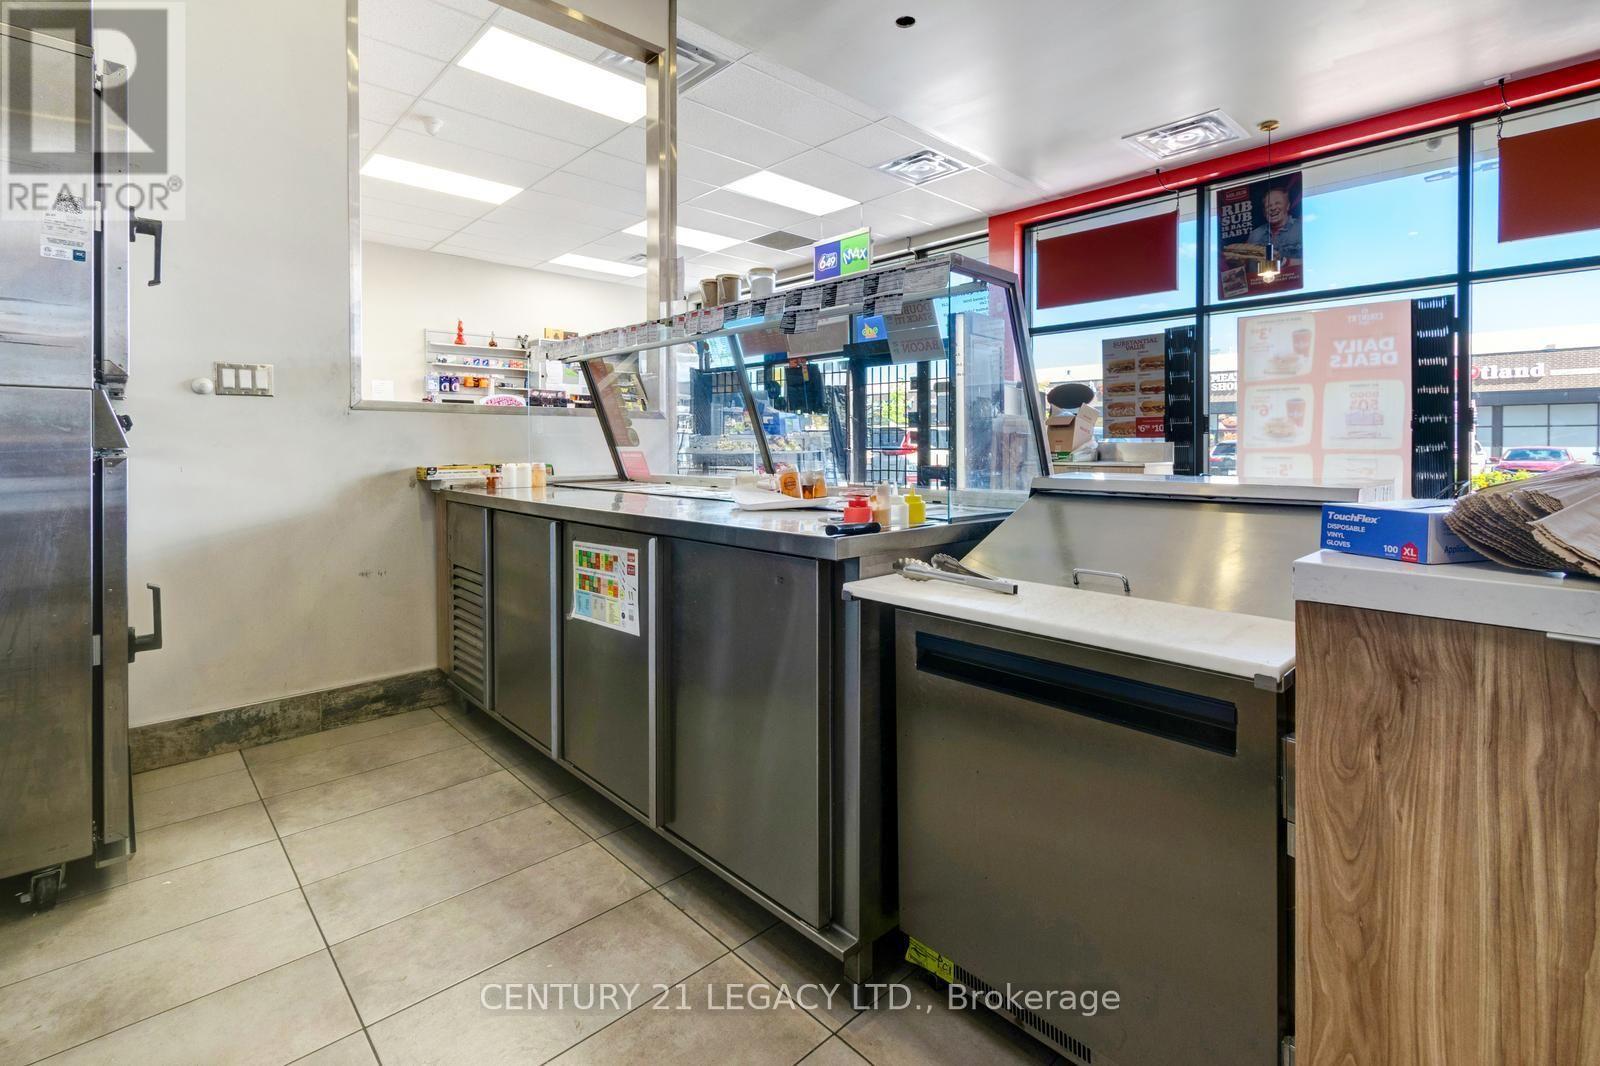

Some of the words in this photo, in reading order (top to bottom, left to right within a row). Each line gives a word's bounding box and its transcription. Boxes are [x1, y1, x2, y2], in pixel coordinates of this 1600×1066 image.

[1222, 200, 1253, 216] RIB
[1222, 212, 1253, 226] SUB
[1231, 222, 1253, 230] BACK
[1222, 228, 1253, 239] BABY!
[843, 247, 868, 265] MAX
[1210, 374, 1237, 383] MEA
[1327, 511, 1379, 524] TouchFlex
[1327, 522, 1366, 533] DISPOSABLE
[1327, 531, 1345, 539] VINYL
[1326, 539, 1351, 548] GLOVES
[1383, 544, 1398, 554] 100
[1403, 547, 1417, 557] XL
